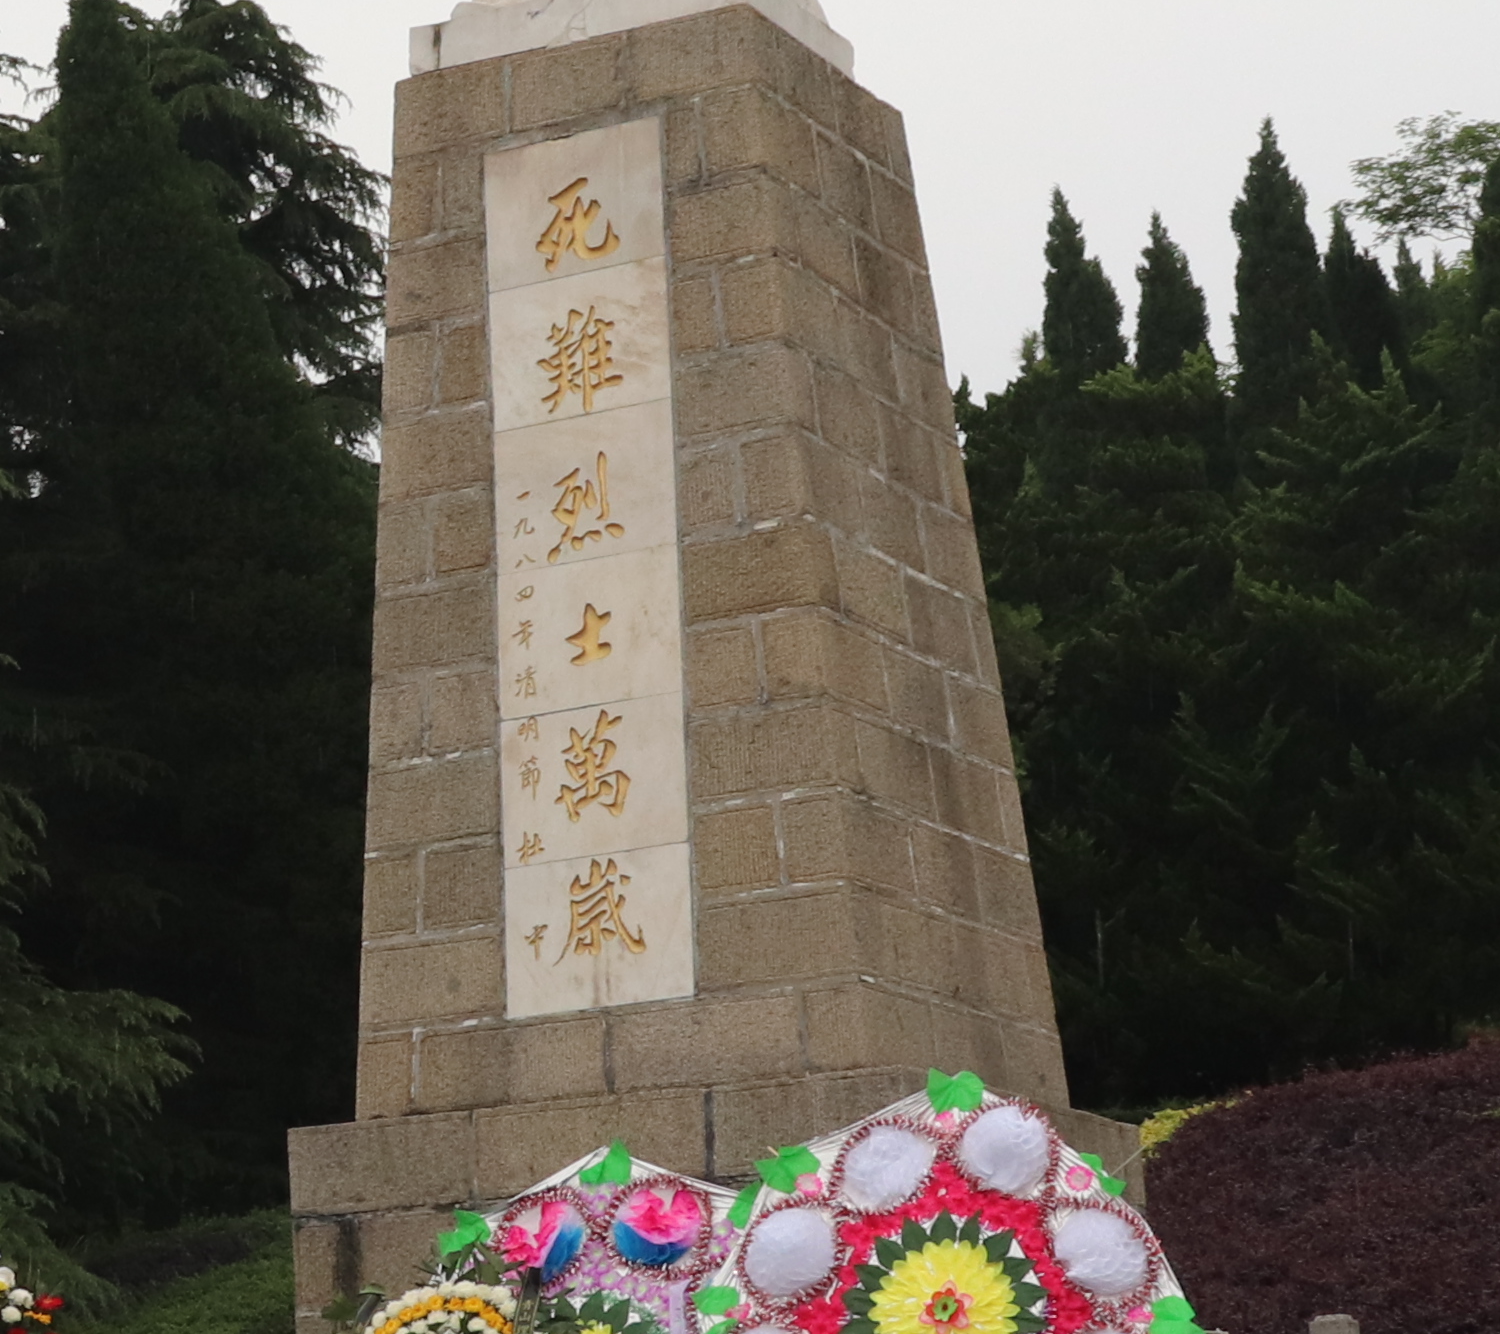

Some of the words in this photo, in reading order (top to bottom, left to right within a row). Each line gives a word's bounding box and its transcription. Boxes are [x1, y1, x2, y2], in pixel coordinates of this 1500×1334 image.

[535, 176, 646, 967] 死難烈士萬歲
